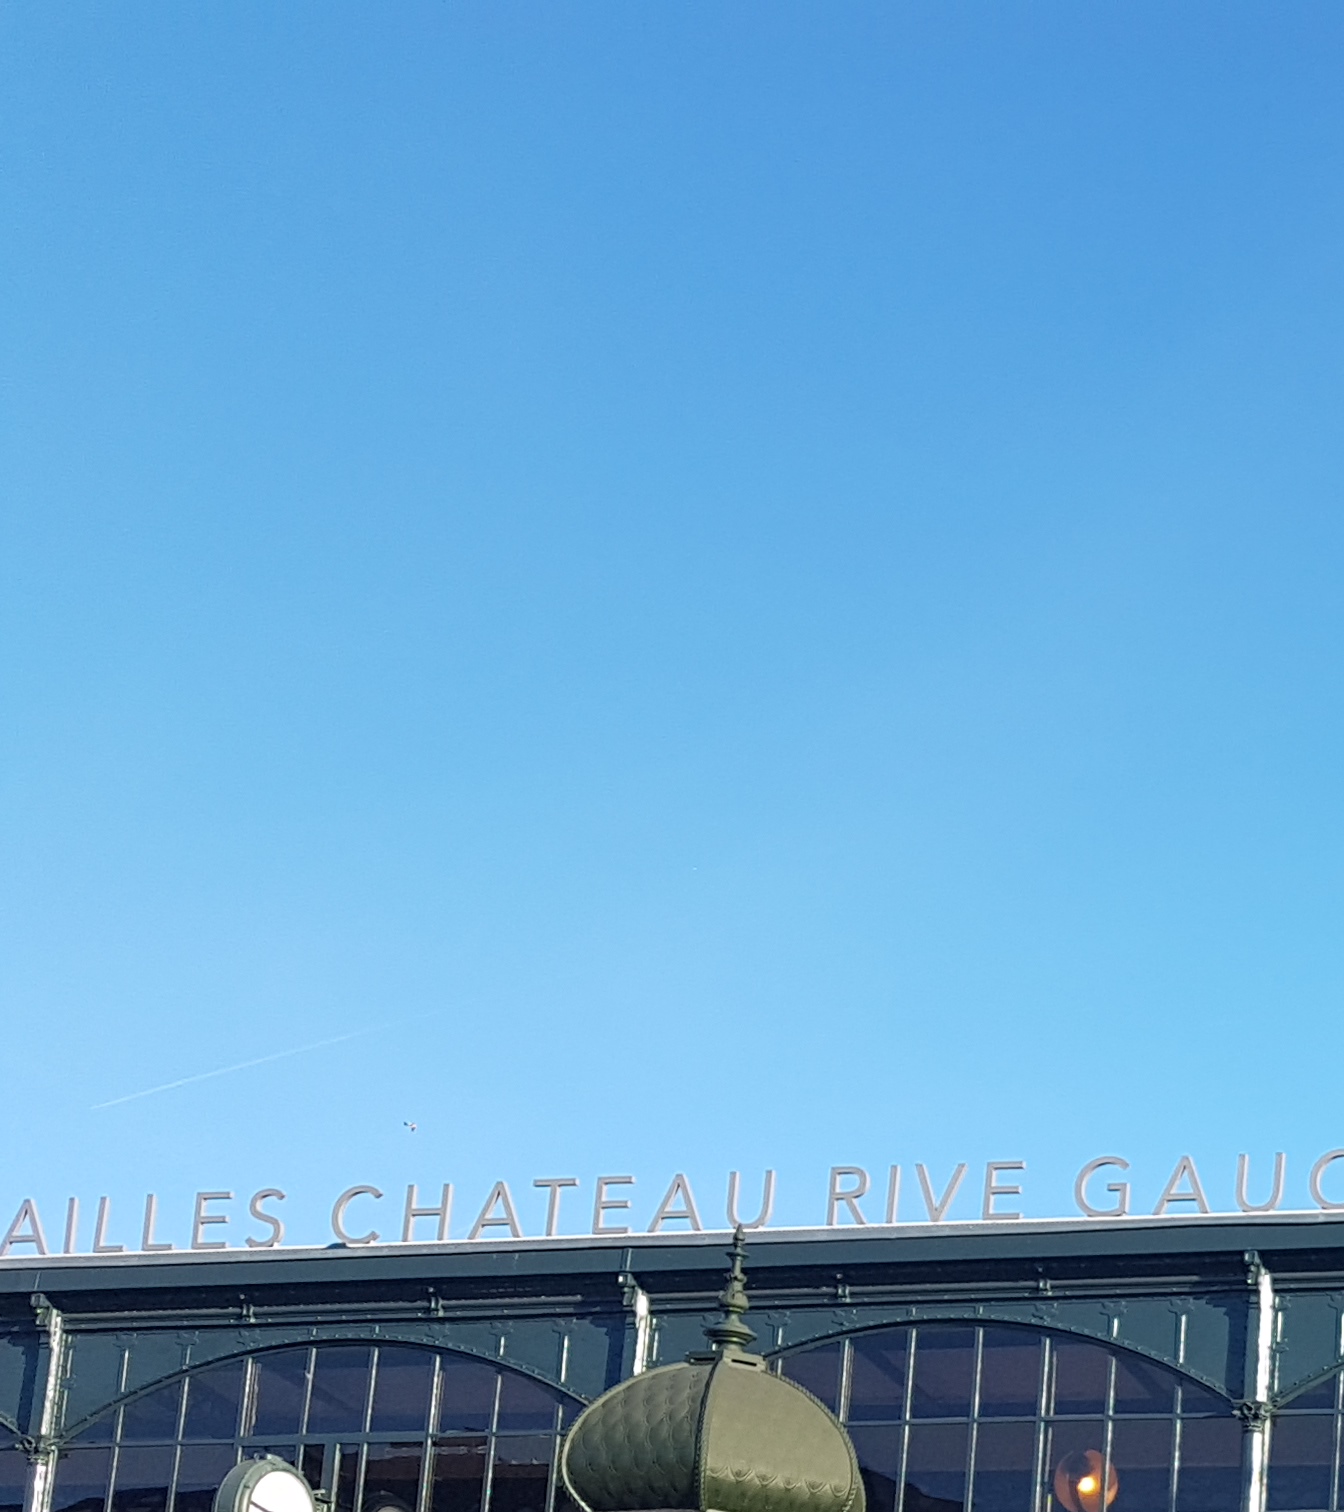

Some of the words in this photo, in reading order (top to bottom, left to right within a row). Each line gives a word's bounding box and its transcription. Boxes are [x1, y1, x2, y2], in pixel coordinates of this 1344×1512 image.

[0, 1188, 287, 1257] AILLES
[330, 1169, 777, 1246] CHATEAU
[826, 1160, 1027, 1227] RIVE
